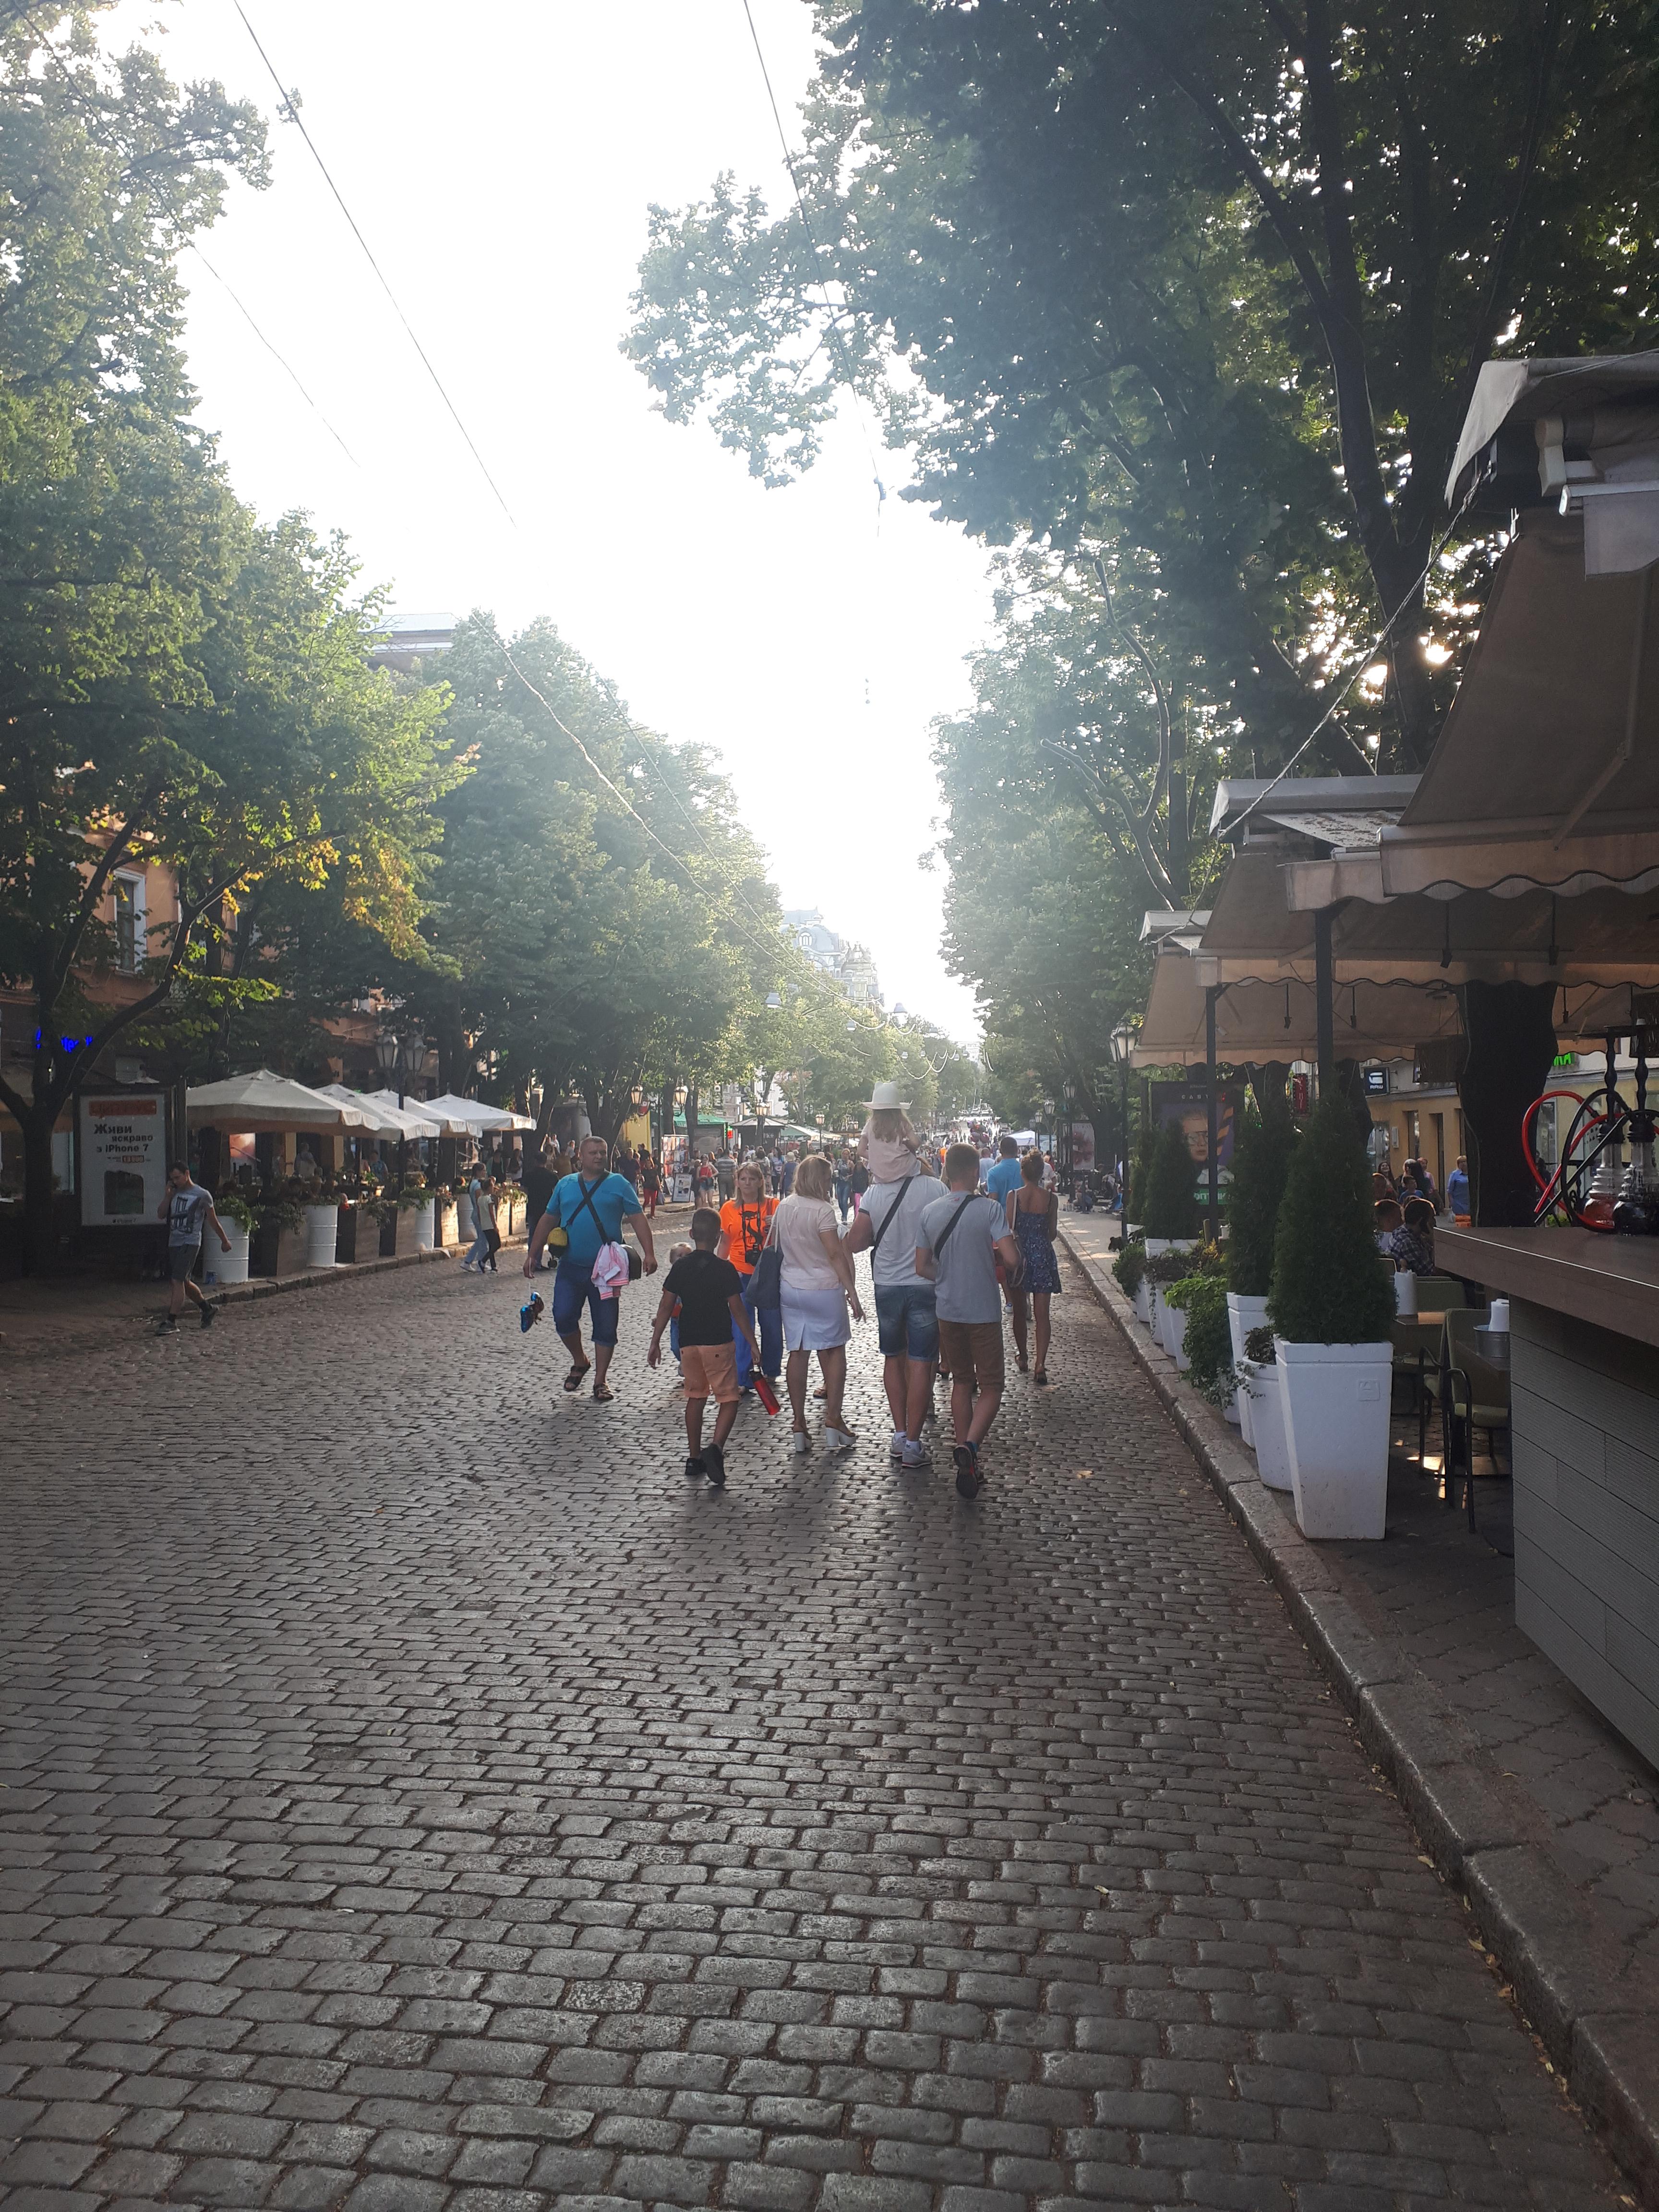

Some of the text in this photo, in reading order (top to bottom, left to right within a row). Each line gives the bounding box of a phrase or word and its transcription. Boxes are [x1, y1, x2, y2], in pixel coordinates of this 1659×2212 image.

[94, 1124, 132, 1134] Живи
[111, 1135, 153, 1143] яскраво
[143, 1143, 149, 1152] 7
